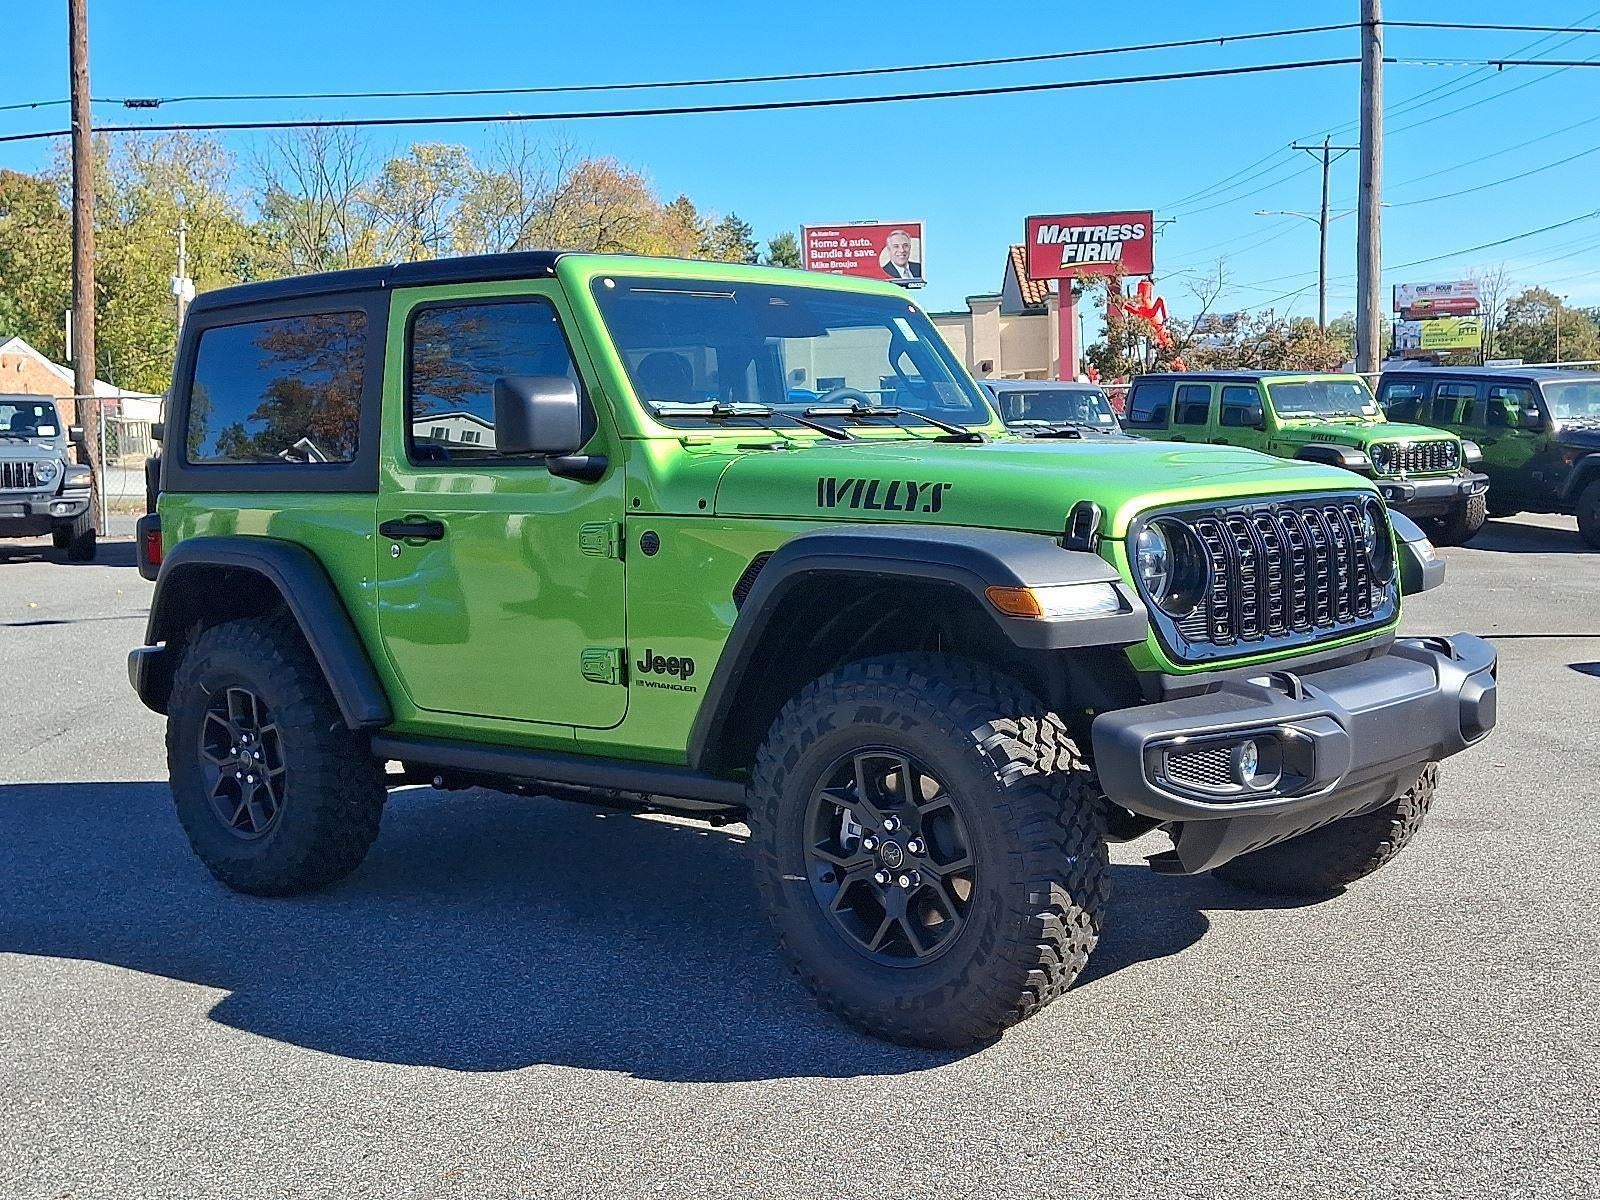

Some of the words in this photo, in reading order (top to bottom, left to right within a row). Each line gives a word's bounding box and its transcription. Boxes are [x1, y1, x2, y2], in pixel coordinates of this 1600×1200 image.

[810, 239, 838, 248] Home
[839, 238, 848, 247] &
[849, 238, 873, 246] auto.
[811, 249, 843, 259] Bundle
[844, 249, 852, 257] &
[853, 249, 878, 257] save.
[1061, 242, 1123, 263] FIRM
[830, 261, 858, 269] Broujos
[817, 477, 953, 513] WILLYS
[636, 648, 695, 681] Jeep
[644, 680, 697, 693] WRANGLER
